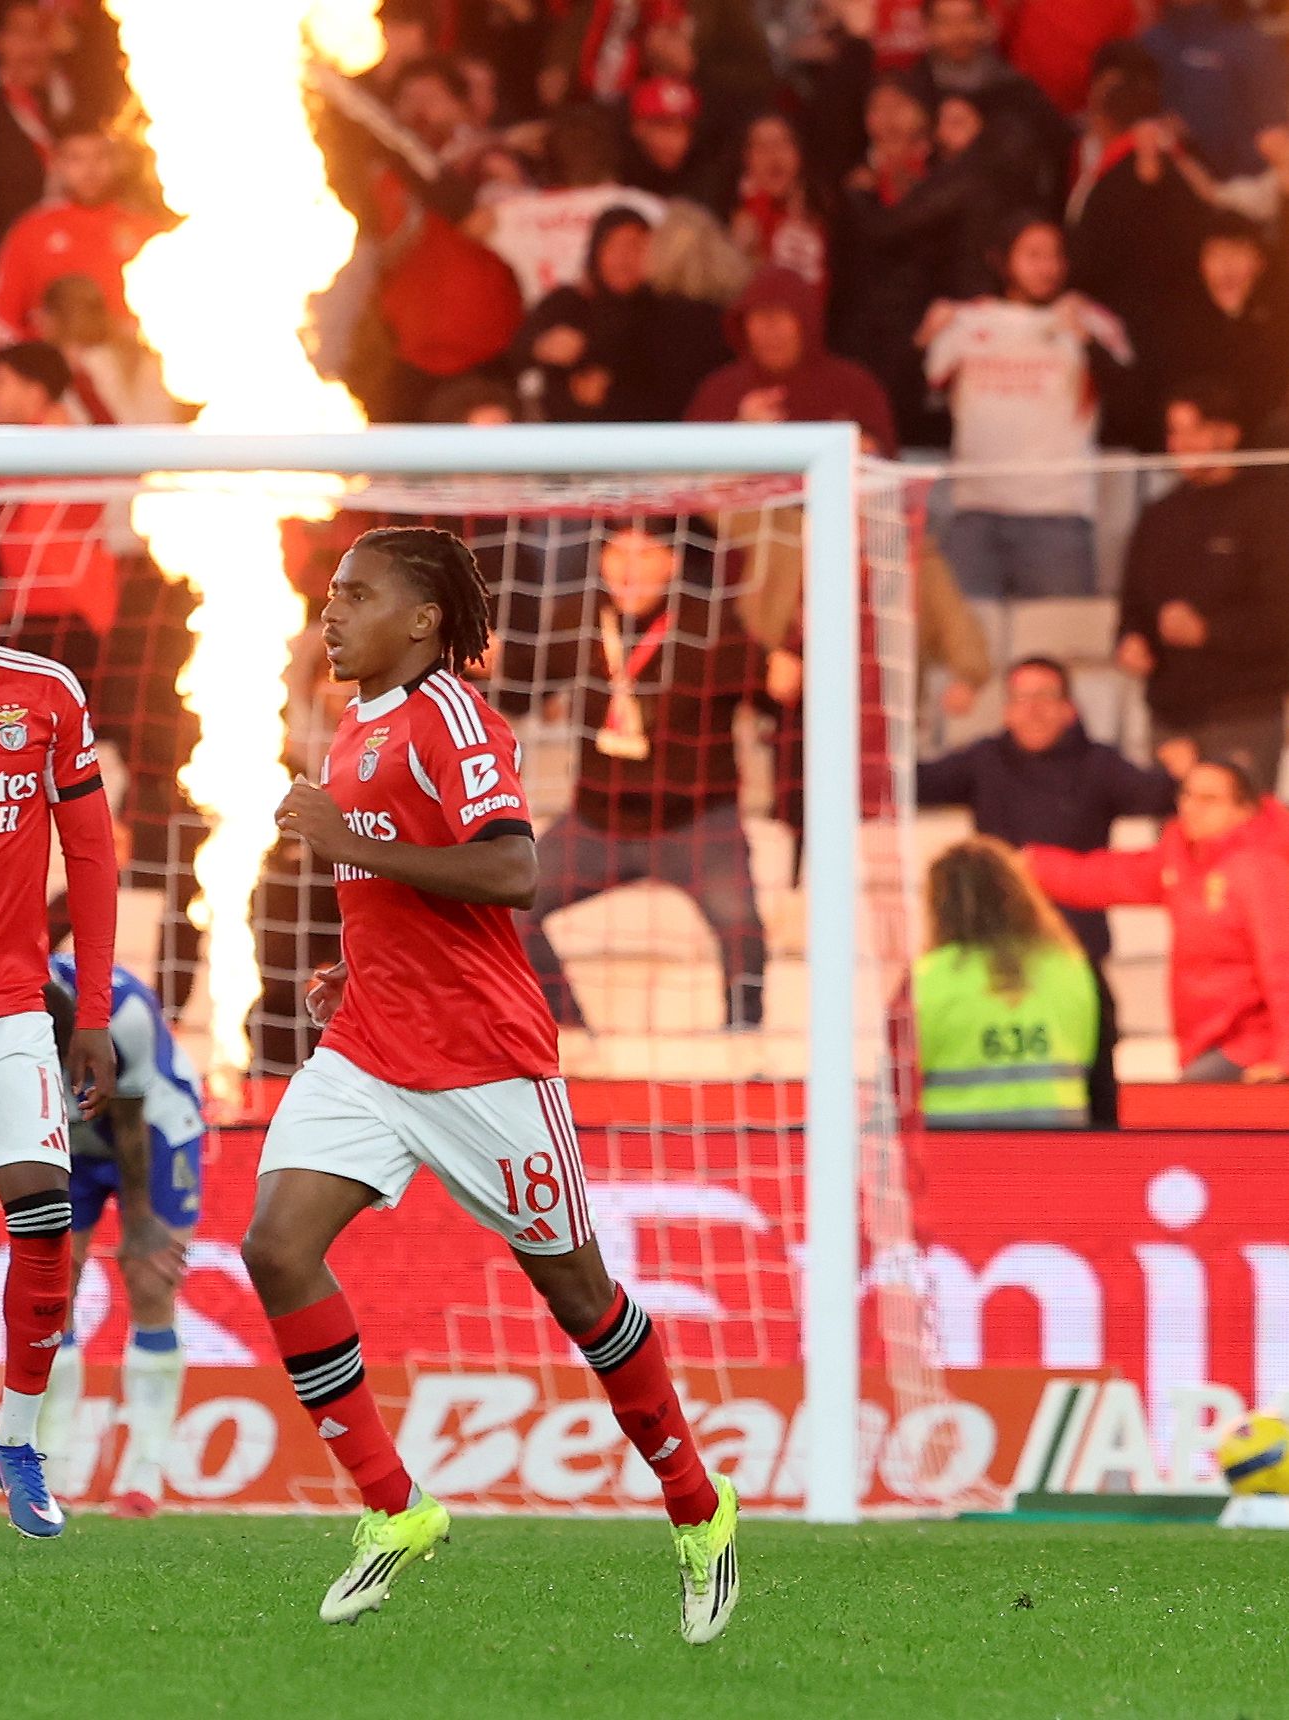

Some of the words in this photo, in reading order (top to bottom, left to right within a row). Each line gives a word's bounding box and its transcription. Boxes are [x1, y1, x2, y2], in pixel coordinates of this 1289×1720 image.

[342, 806, 397, 841] ates
[459, 794, 520, 826] Betano
[495, 1151, 560, 1215] 18
